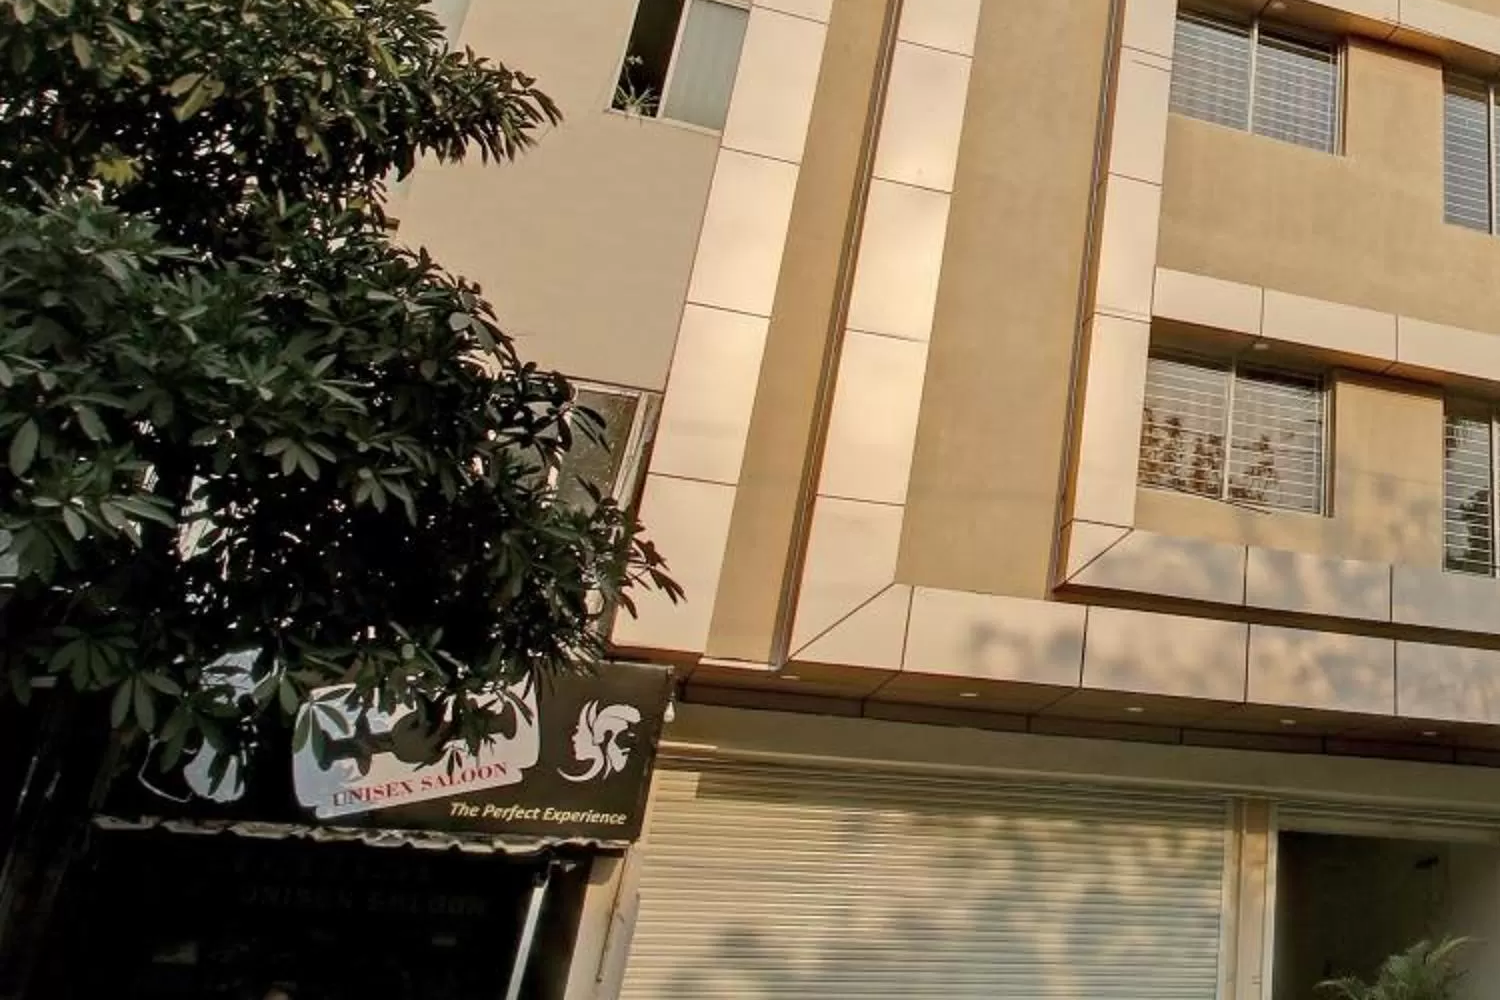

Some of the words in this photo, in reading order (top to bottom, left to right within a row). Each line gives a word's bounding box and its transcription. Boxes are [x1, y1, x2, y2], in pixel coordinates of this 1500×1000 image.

[331, 780, 415, 808] UNISEX
[421, 761, 509, 793] SALOON
[450, 801, 481, 818] The
[482, 804, 541, 822] Perfect
[542, 807, 628, 826] Experience
